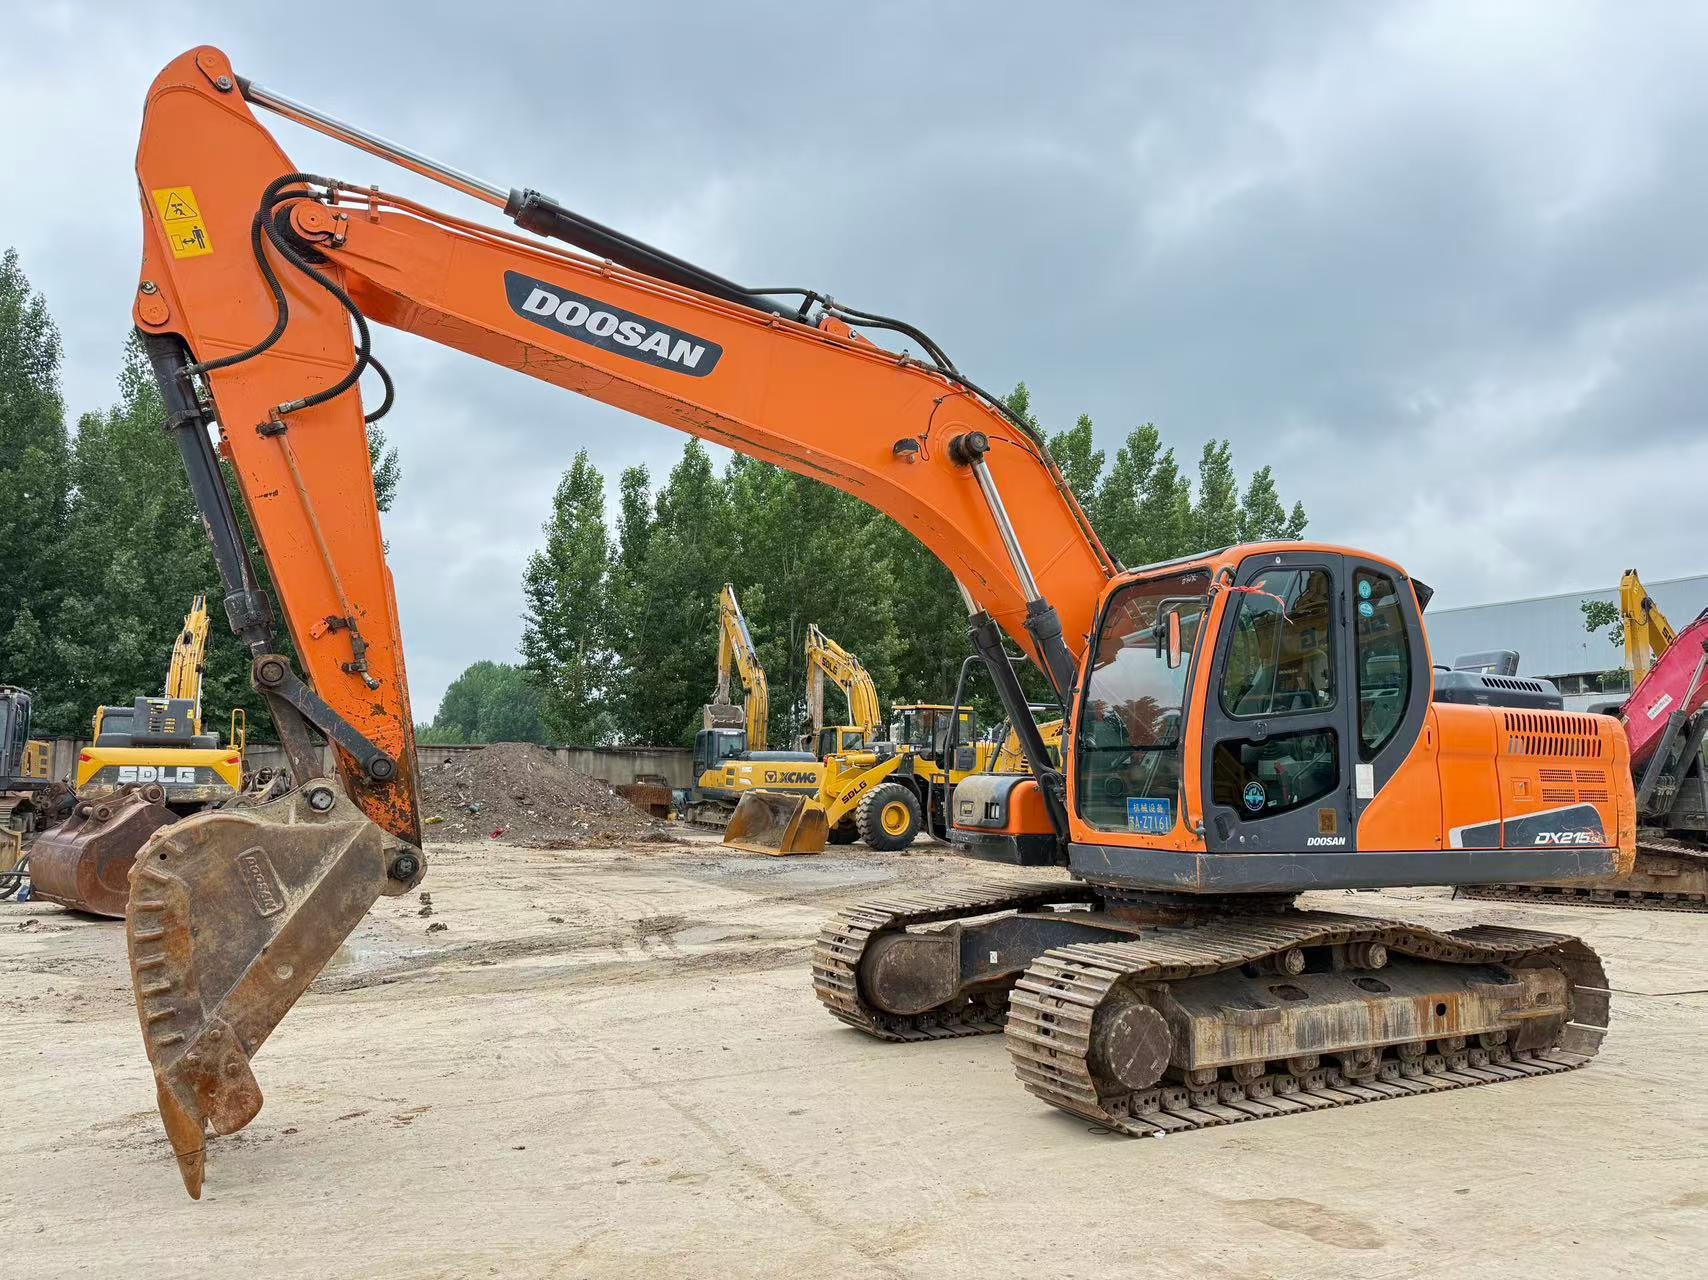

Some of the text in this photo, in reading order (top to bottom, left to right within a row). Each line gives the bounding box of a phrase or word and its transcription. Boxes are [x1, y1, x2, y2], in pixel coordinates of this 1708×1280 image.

[521, 287, 706, 368] DOOSAN
[821, 656, 838, 675] SDLG
[118, 766, 195, 783] SDLG
[778, 771, 817, 784] XCMG
[841, 780, 868, 804] SDLG
[1307, 836, 1346, 846] DOOSAN
